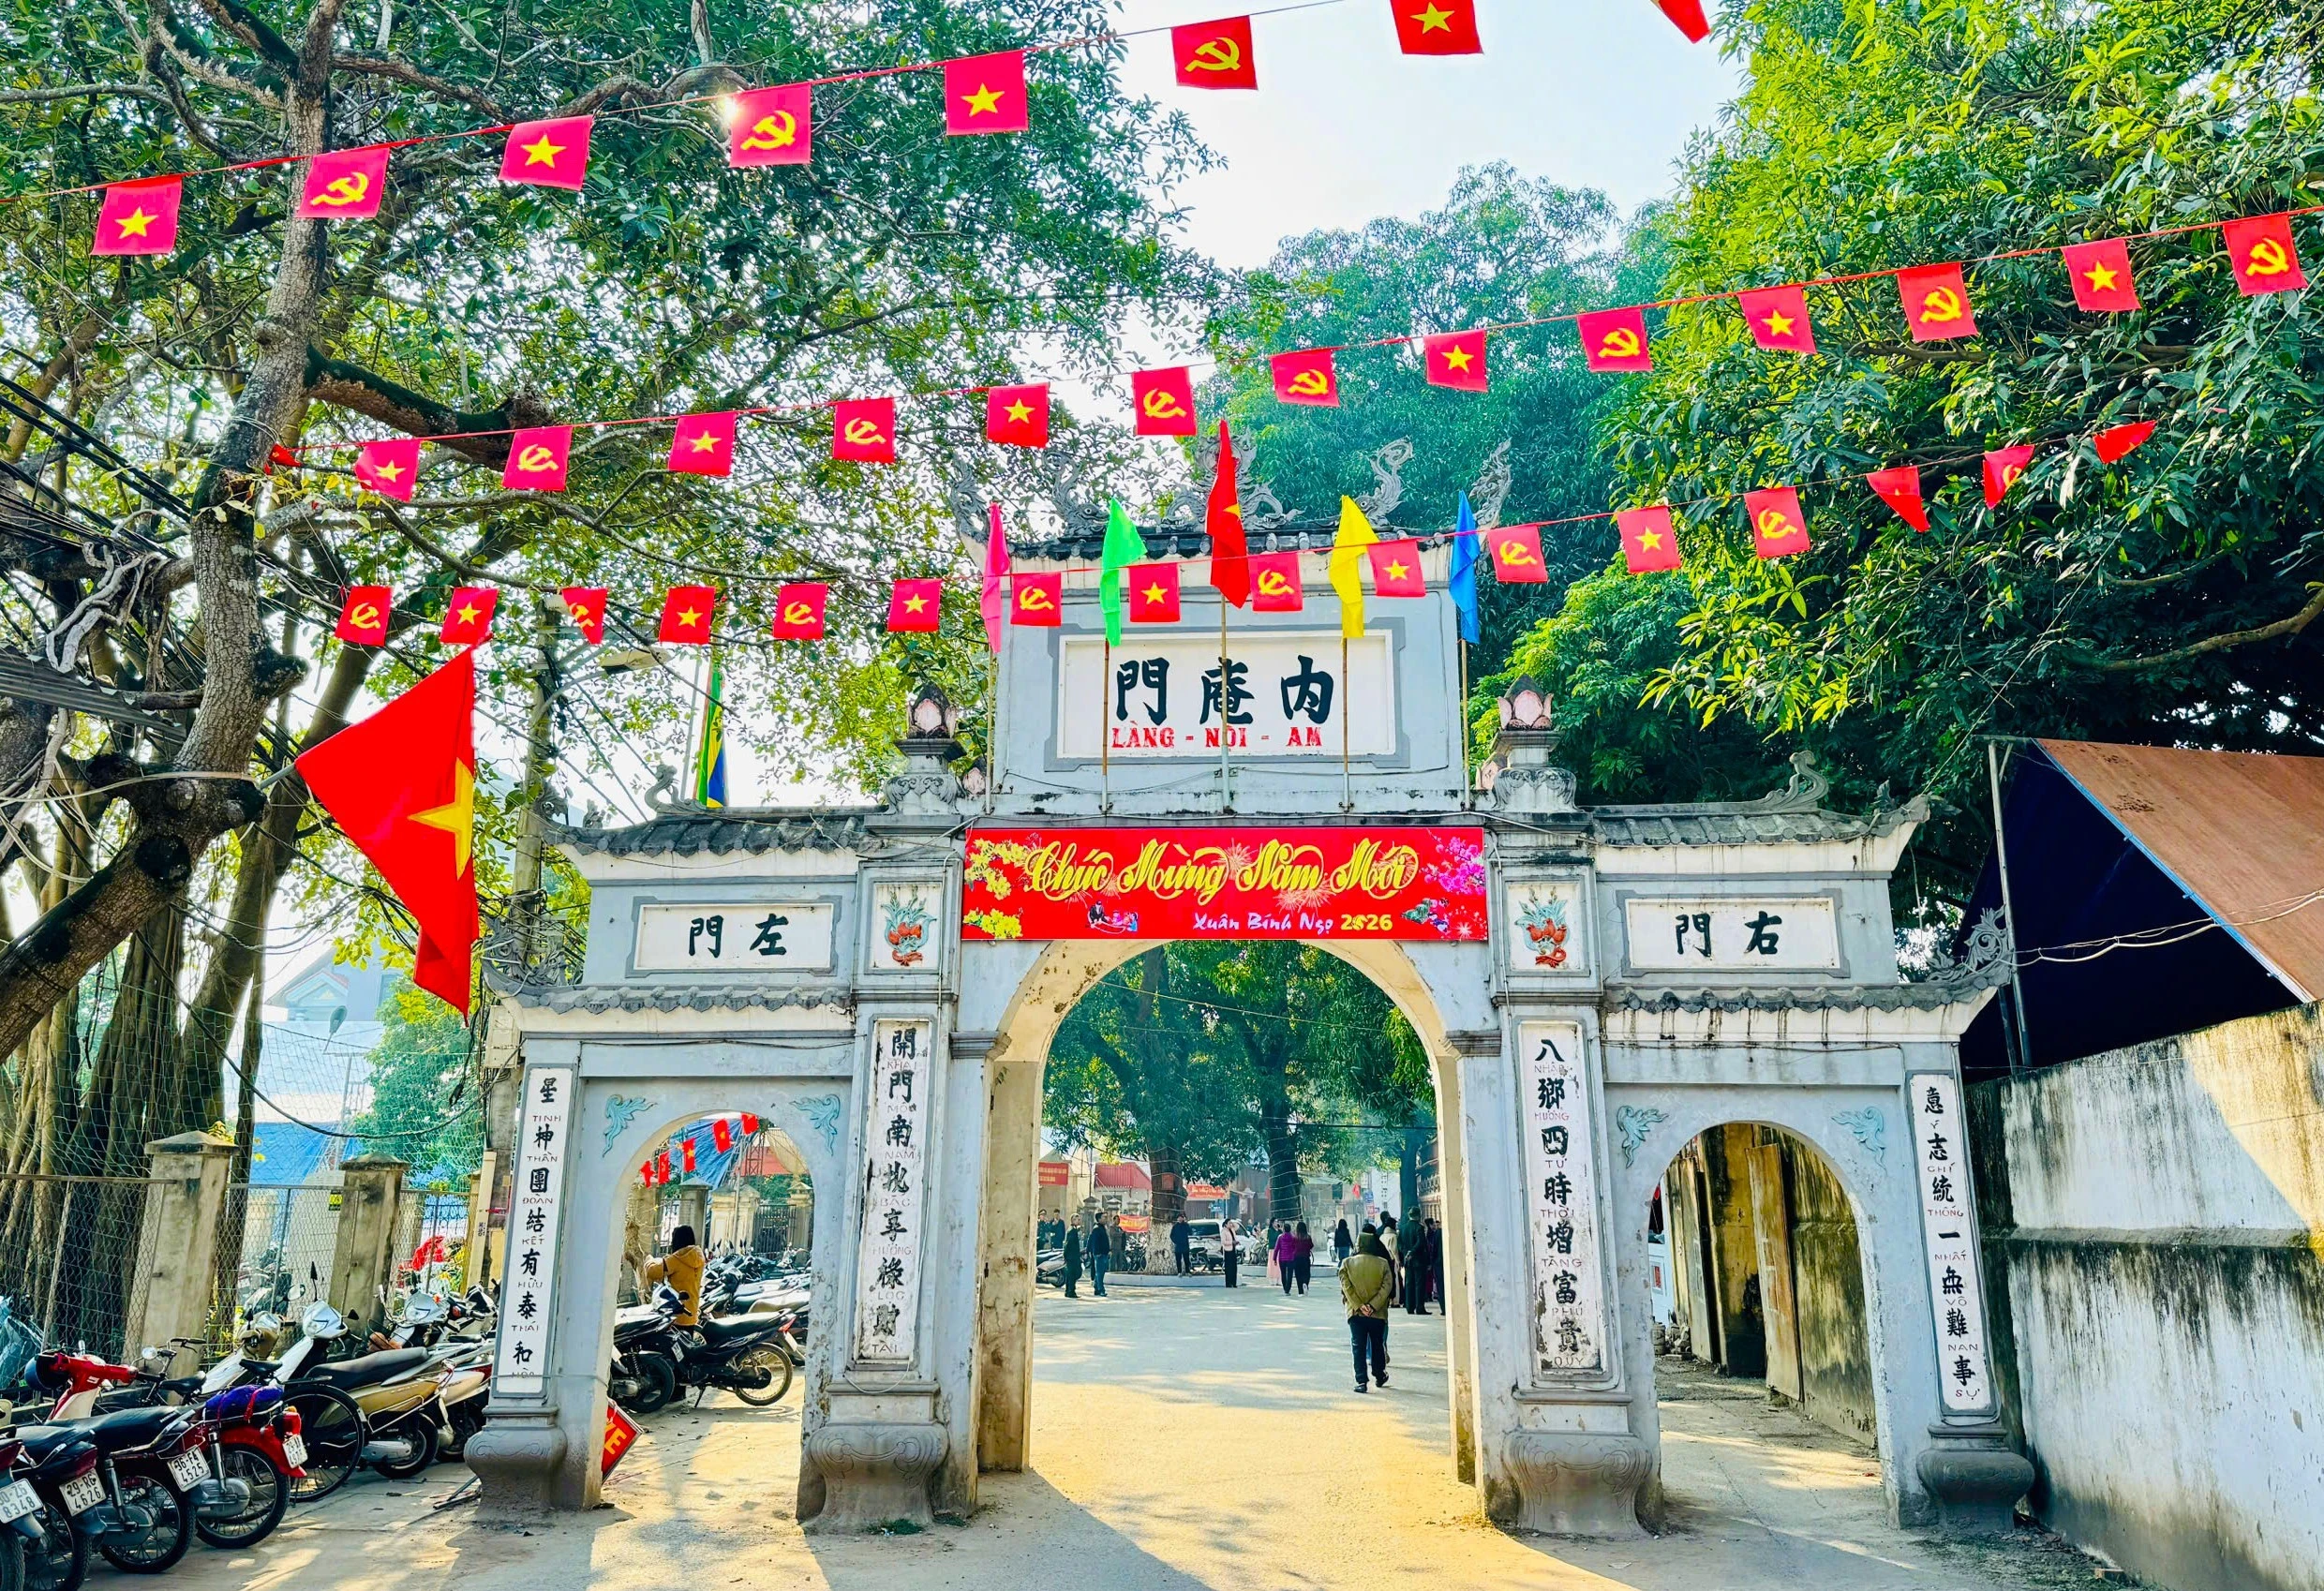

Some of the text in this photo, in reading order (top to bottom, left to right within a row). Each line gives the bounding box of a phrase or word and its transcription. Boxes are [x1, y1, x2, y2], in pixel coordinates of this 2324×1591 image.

[1111, 721, 1175, 749] LÀNG
[1287, 726, 1323, 747] AM
[1024, 840, 1115, 901] Chúc
[1193, 912, 1240, 930] Xuân
[1247, 912, 1292, 930] Bính
[1299, 912, 1333, 935] Ngọ
[1930, 1119, 1940, 1129] Ý
[527, 1152, 558, 1163] THẦN
[885, 1151, 915, 1159] NAM
[1927, 1162, 1956, 1173] CHÍ
[522, 1193, 554, 1204] ĐOÀN
[1927, 1206, 1964, 1218] THỐNG
[521, 1234, 544, 1245] KẾT
[1934, 1249, 1967, 1261] NHẤT
[1542, 1256, 1583, 1267] TĂNG
[1945, 1296, 1967, 1306] VÔ
[511, 1320, 539, 1332] THÁI
[872, 1340, 898, 1353] TÀI
[182, 1463, 204, 1482] 4525
[74, 1486, 101, 1509] 4626
